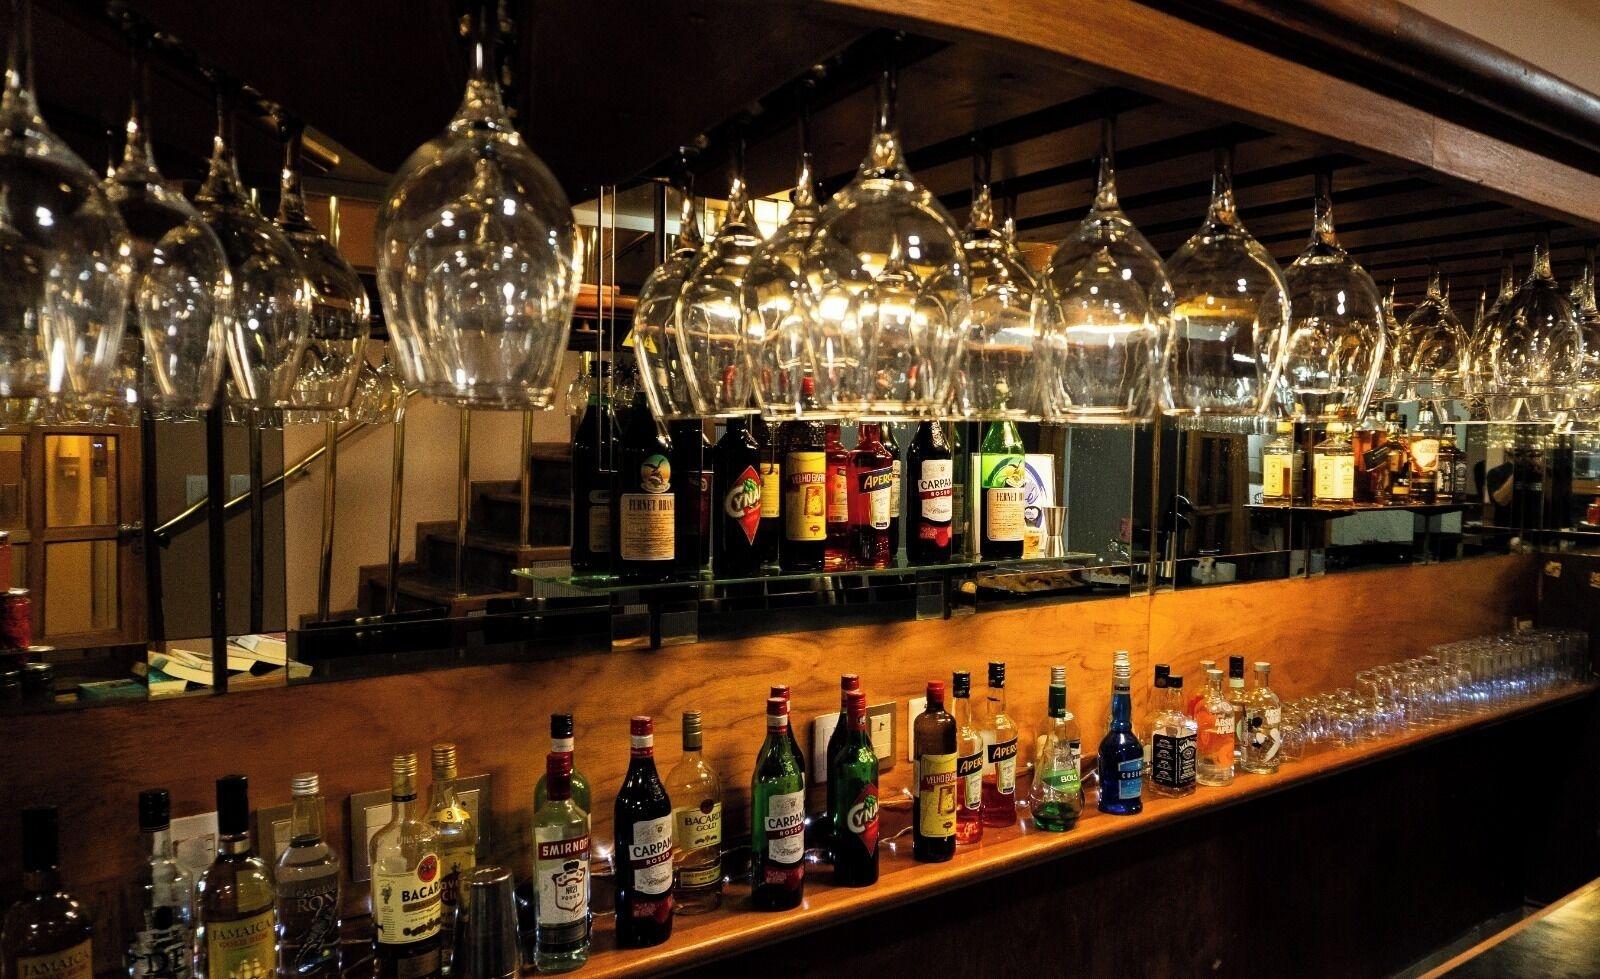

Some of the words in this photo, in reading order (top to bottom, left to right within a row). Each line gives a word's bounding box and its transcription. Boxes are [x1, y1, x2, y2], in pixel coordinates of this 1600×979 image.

[864, 472, 892, 489] APERO
[1060, 774, 1078, 783] BOLS
[446, 810, 453, 820] 3
[696, 822, 717, 832] GOLD
[780, 825, 802, 837] ROSSO
[633, 837, 672, 857] CARPAN
[646, 851, 670, 865] ROSSO
[402, 879, 441, 902] BACAR
[212, 919, 272, 940] JAMAICA
